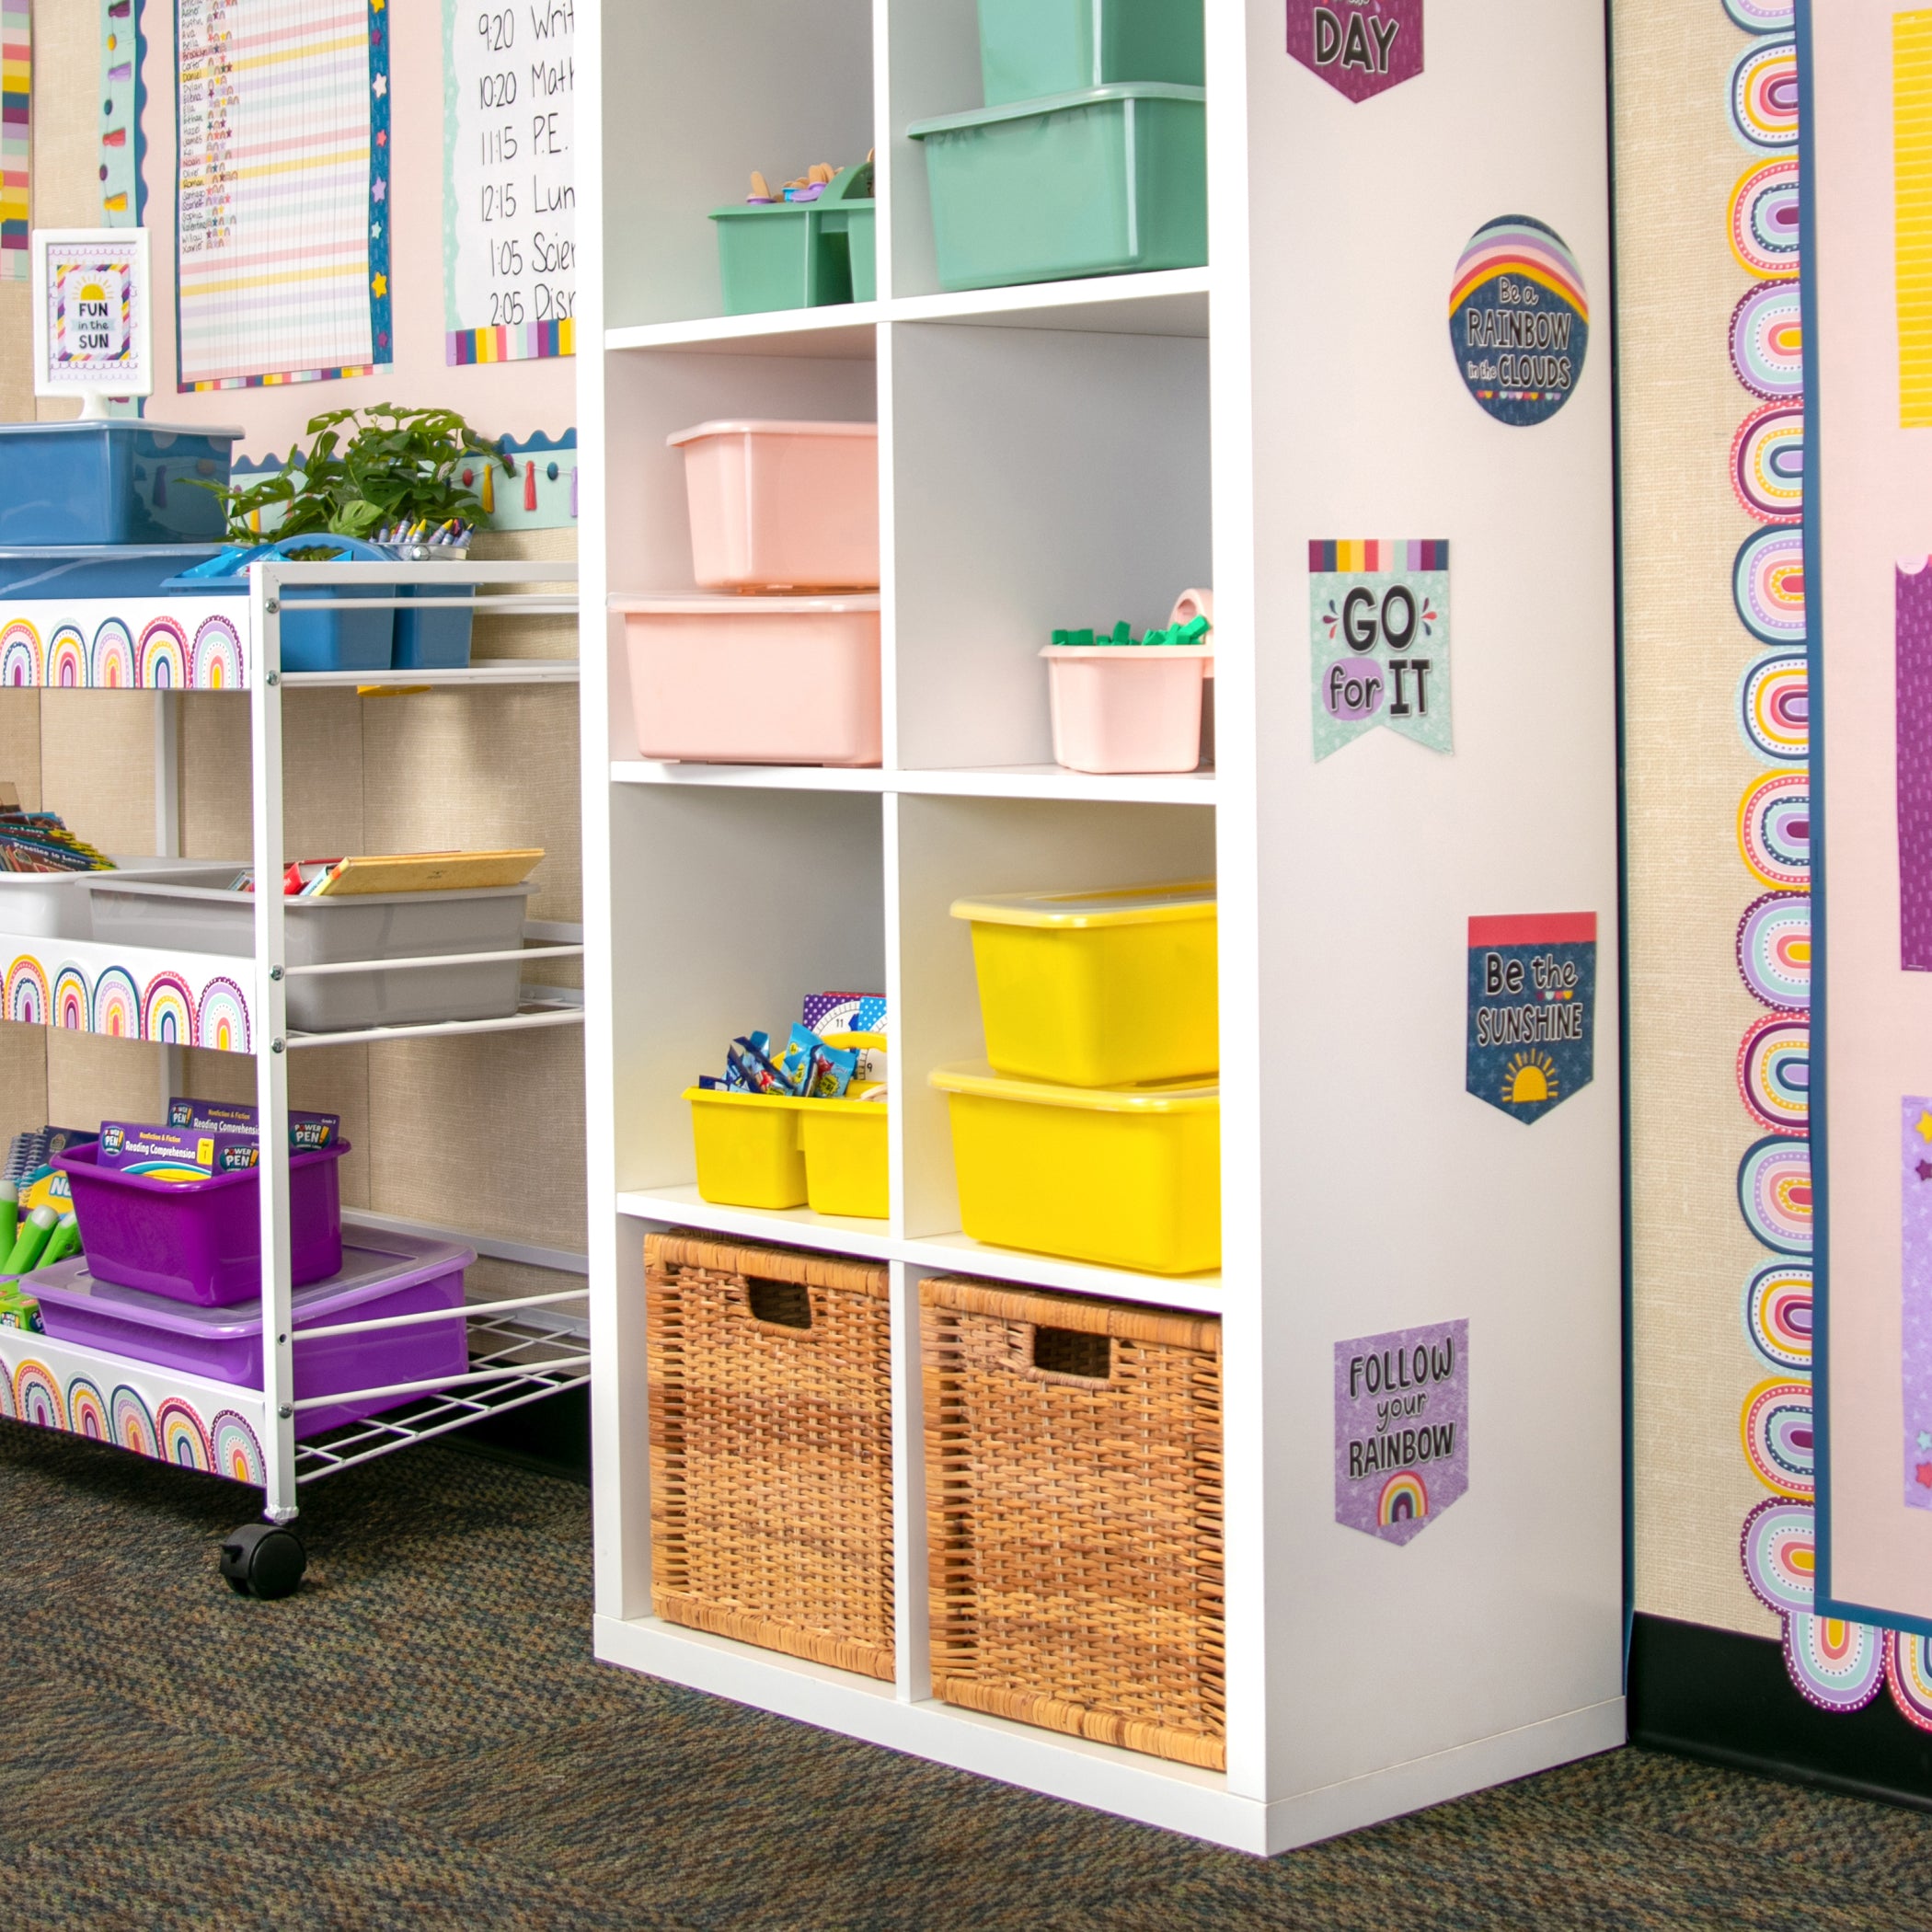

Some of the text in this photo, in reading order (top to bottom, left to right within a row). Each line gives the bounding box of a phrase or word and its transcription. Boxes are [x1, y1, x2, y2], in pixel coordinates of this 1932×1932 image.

[478, 8, 514, 51] 9:20
[1315, 7, 1399, 74] DAY
[480, 71, 516, 109] 10:20
[482, 112, 569, 166] 11:15 P.E.
[482, 183, 516, 222] 12:15
[491, 238, 523, 277] 1:05
[1500, 277, 1538, 305] Be a
[78, 319, 109, 330] in the
[79, 303, 109, 316] FUN
[490, 292, 523, 327] 2:05
[79, 333, 109, 349] SUN
[1467, 308, 1571, 350] RAINBOW
[1467, 354, 1571, 389] in the CLOUDS
[1342, 584, 1418, 653] GO
[1330, 659, 1432, 717] for IT
[1486, 952, 1578, 995] Be the
[835, 1018, 844, 1029] 11
[1478, 1003, 1582, 1046] SUNSHINE
[867, 1063, 873, 1073] 9
[193, 1118, 218, 1132] Reading
[236, 1112, 250, 1121] Fiction
[294, 1123, 322, 1133] POWER
[125, 1140, 196, 1159] Reading Comprehension
[166, 1134, 181, 1143] Fiction
[224, 1146, 251, 1156] POWER
[1350, 1336, 1455, 1397] FOLLOW
[1376, 1392, 1428, 1432] your
[1349, 1421, 1455, 1478] RAINBOW
